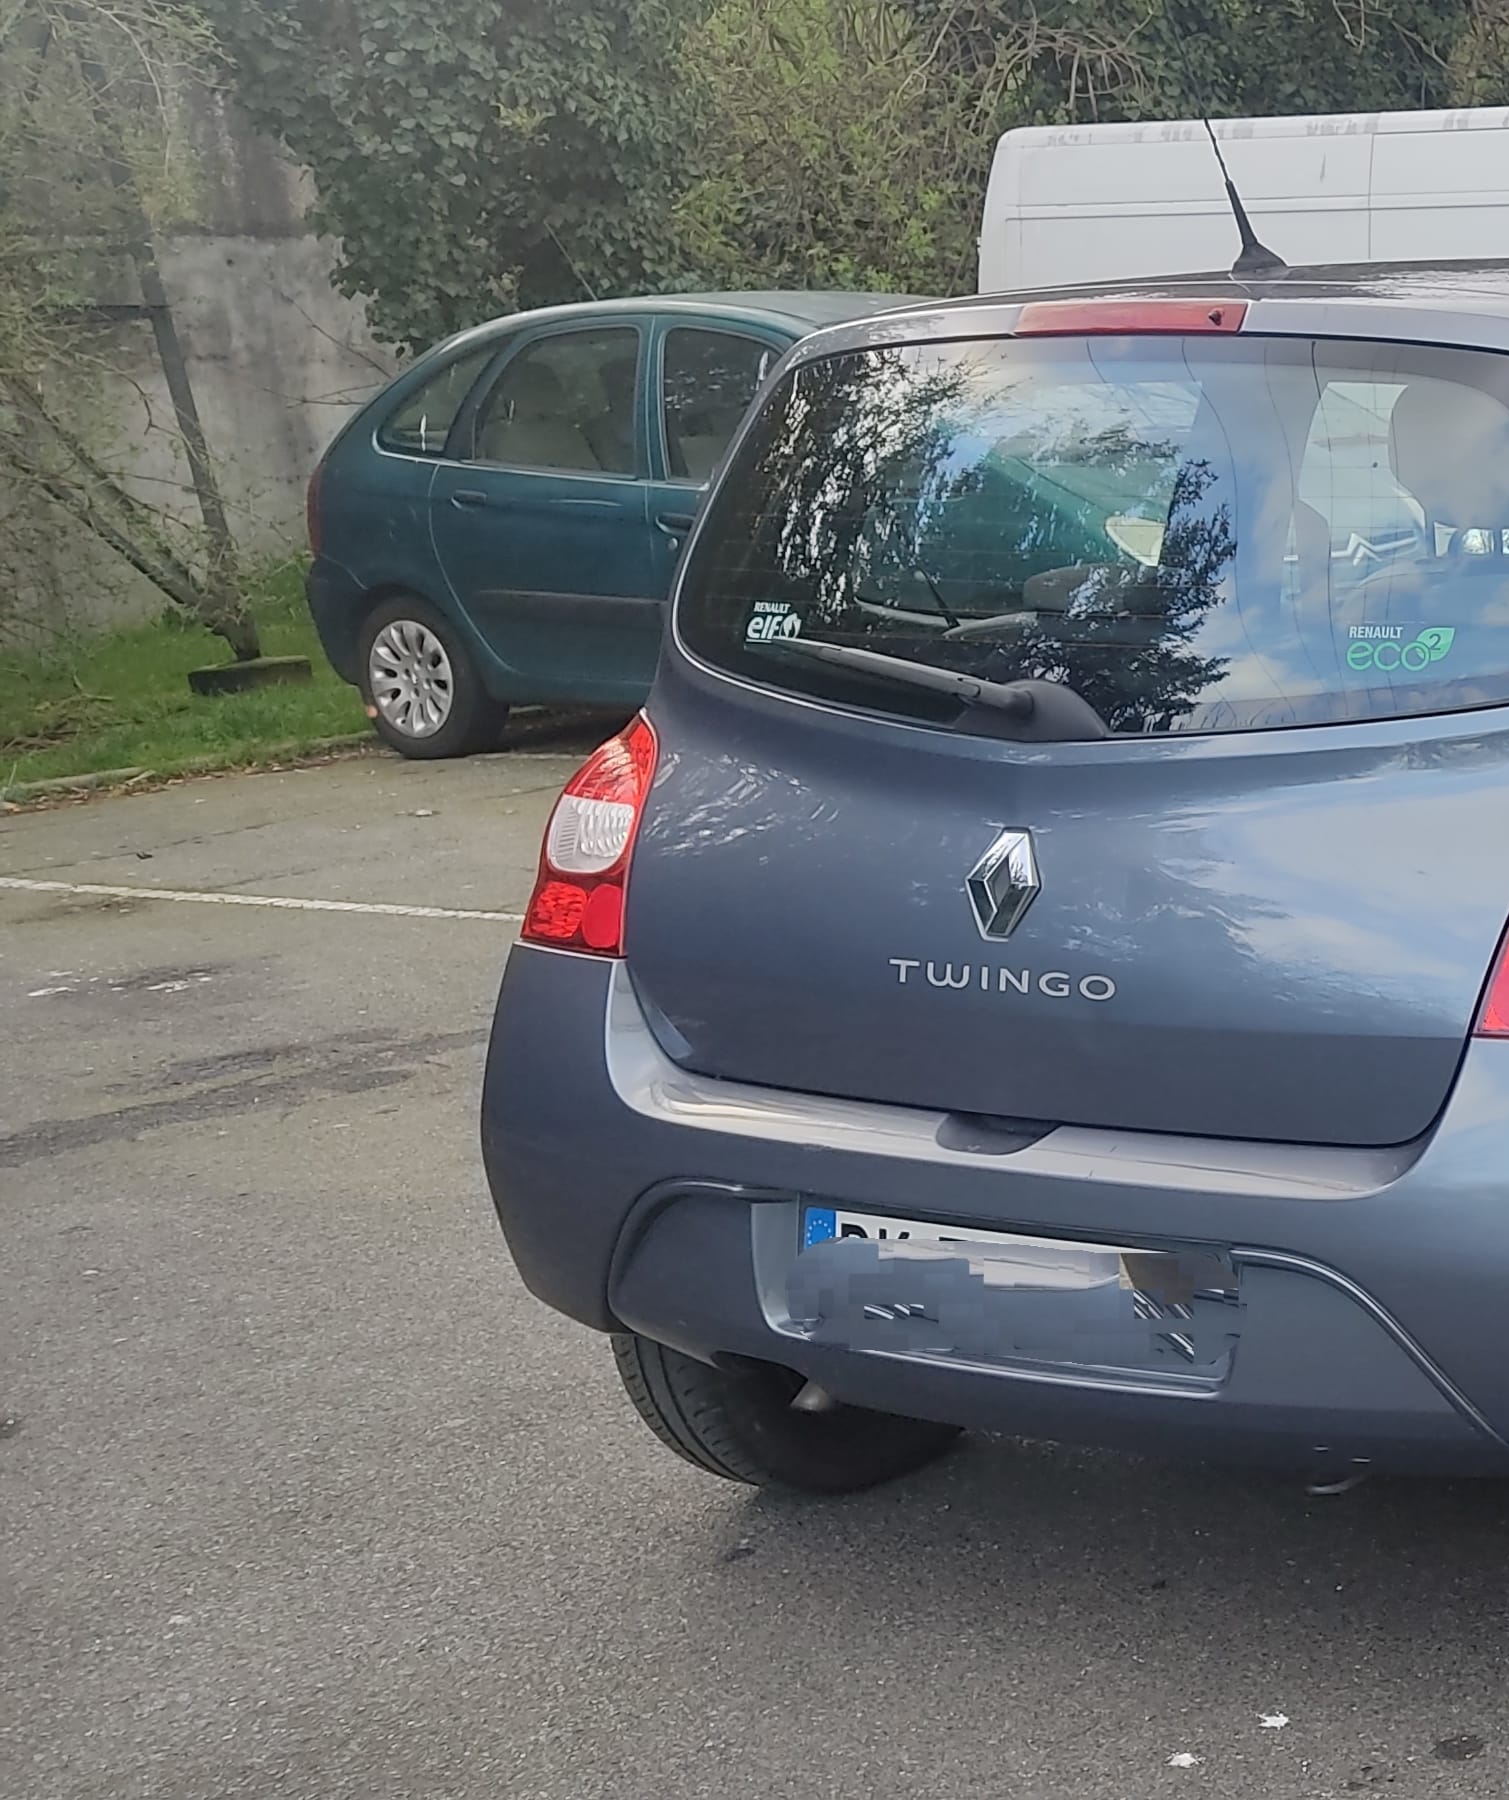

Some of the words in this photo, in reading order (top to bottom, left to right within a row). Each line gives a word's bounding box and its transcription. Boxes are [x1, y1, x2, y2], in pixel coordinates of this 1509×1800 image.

[753, 601, 791, 614] RENAULT
[1349, 626, 1403, 639] RENAULT
[888, 957, 1117, 1002] TWINGO
